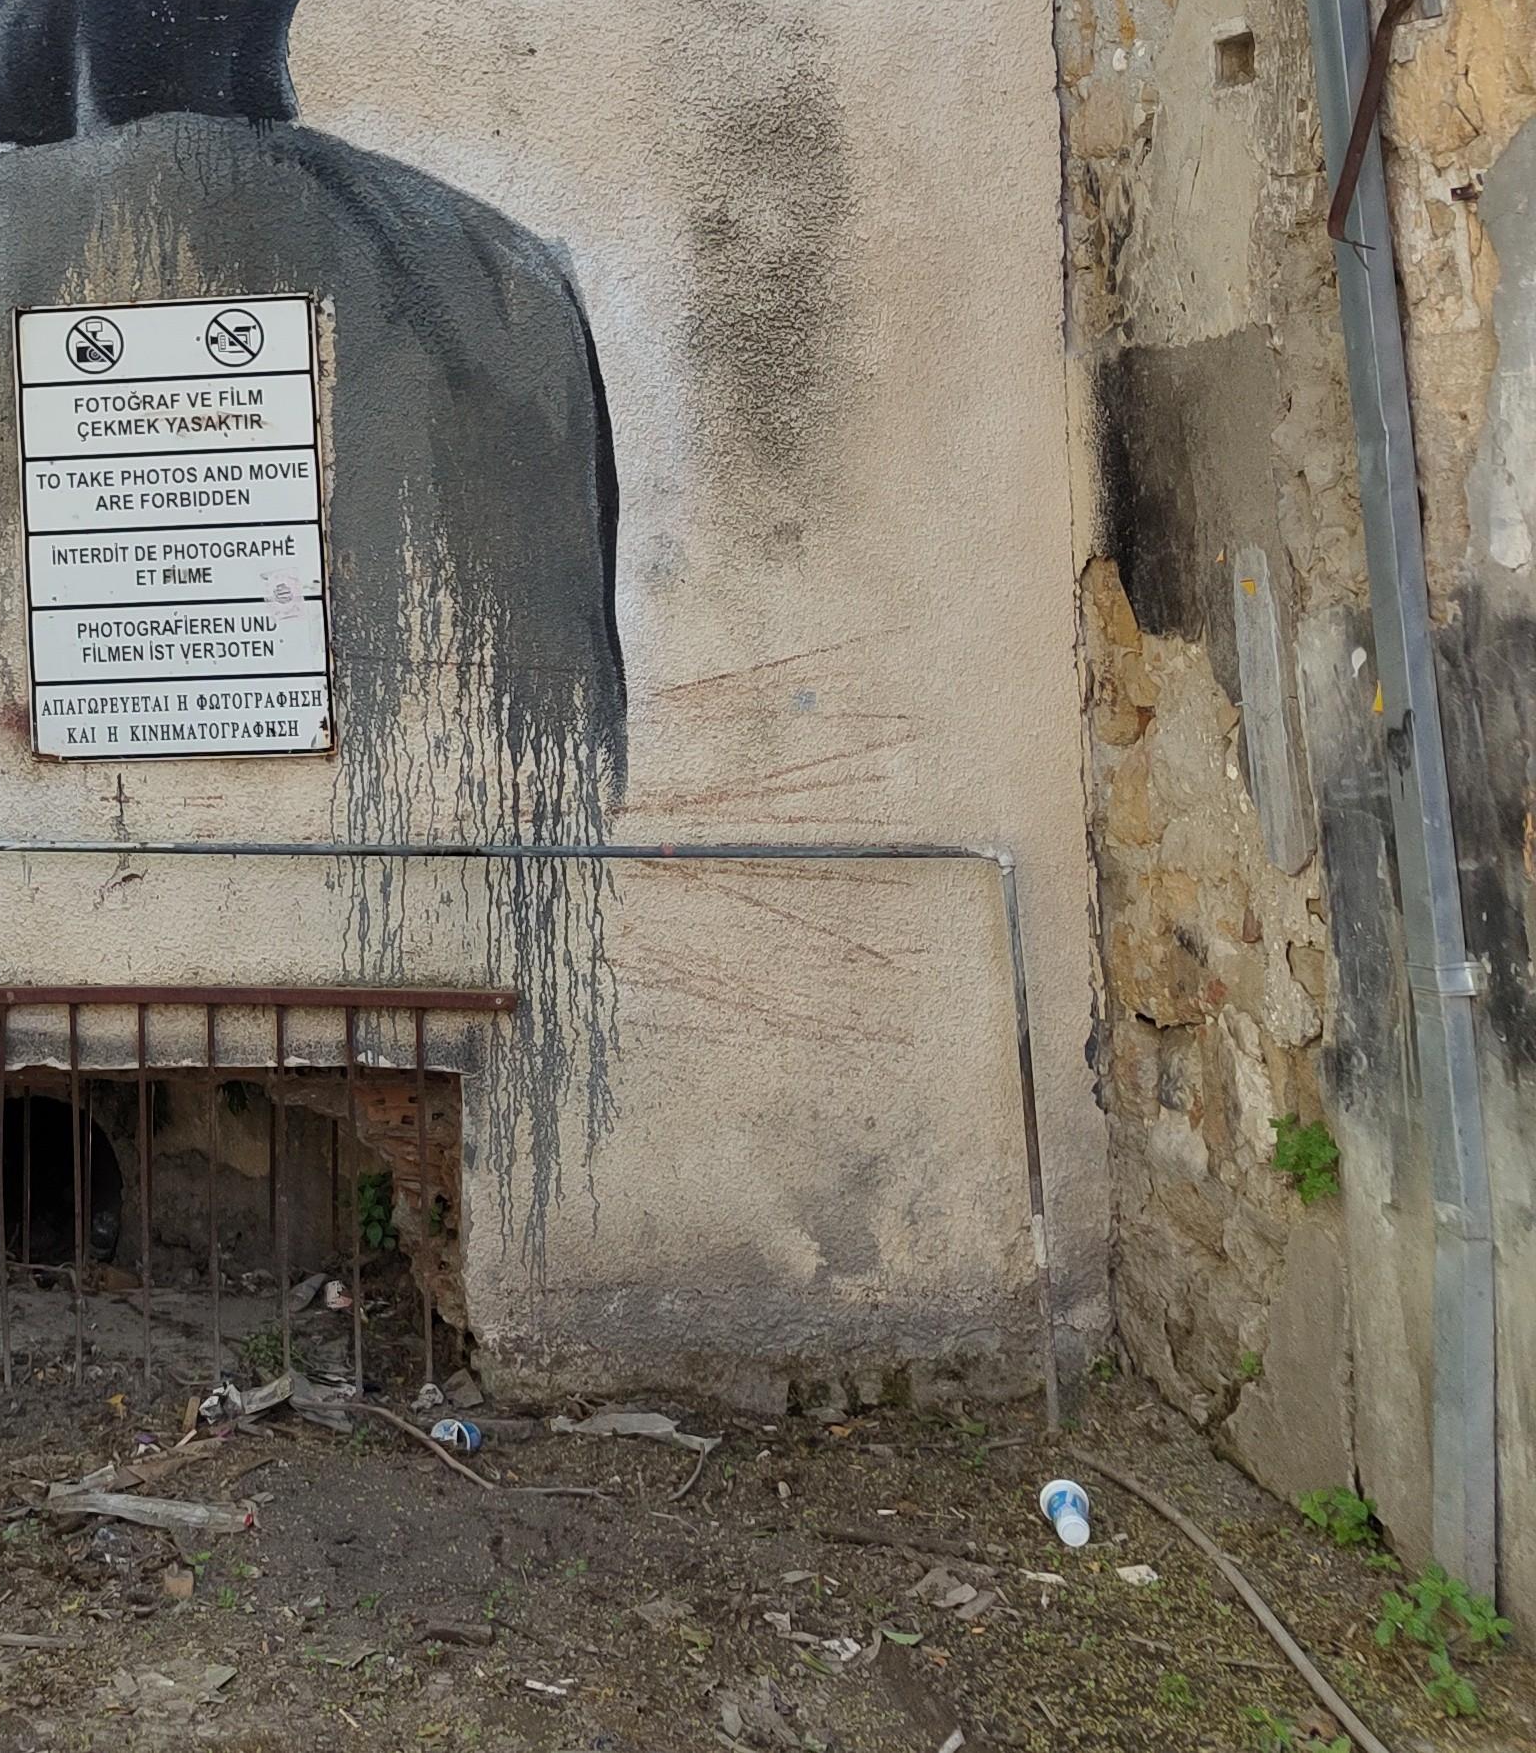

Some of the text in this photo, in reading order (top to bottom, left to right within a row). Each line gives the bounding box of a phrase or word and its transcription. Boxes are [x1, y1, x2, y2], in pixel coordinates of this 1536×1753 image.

[73, 386, 264, 414] FOTOĞRAF VE FİLM
[77, 413, 263, 442] ÇEKMEK YASAKTIR
[36, 462, 310, 490] TO TAKE PHOTOS AND MOVIE
[95, 489, 251, 511] ARE FORBIDDEN
[134, 545, 158, 562] DE
[136, 569, 157, 586] ET
[241, 615, 278, 633] UND
[179, 640, 275, 660] VERBOTEN
[41, 695, 170, 716] ΑΠΑΓΩΡΕΥΕΤΑΙ
[177, 694, 189, 711] Η
[67, 726, 97, 744] ΚΑΙ
